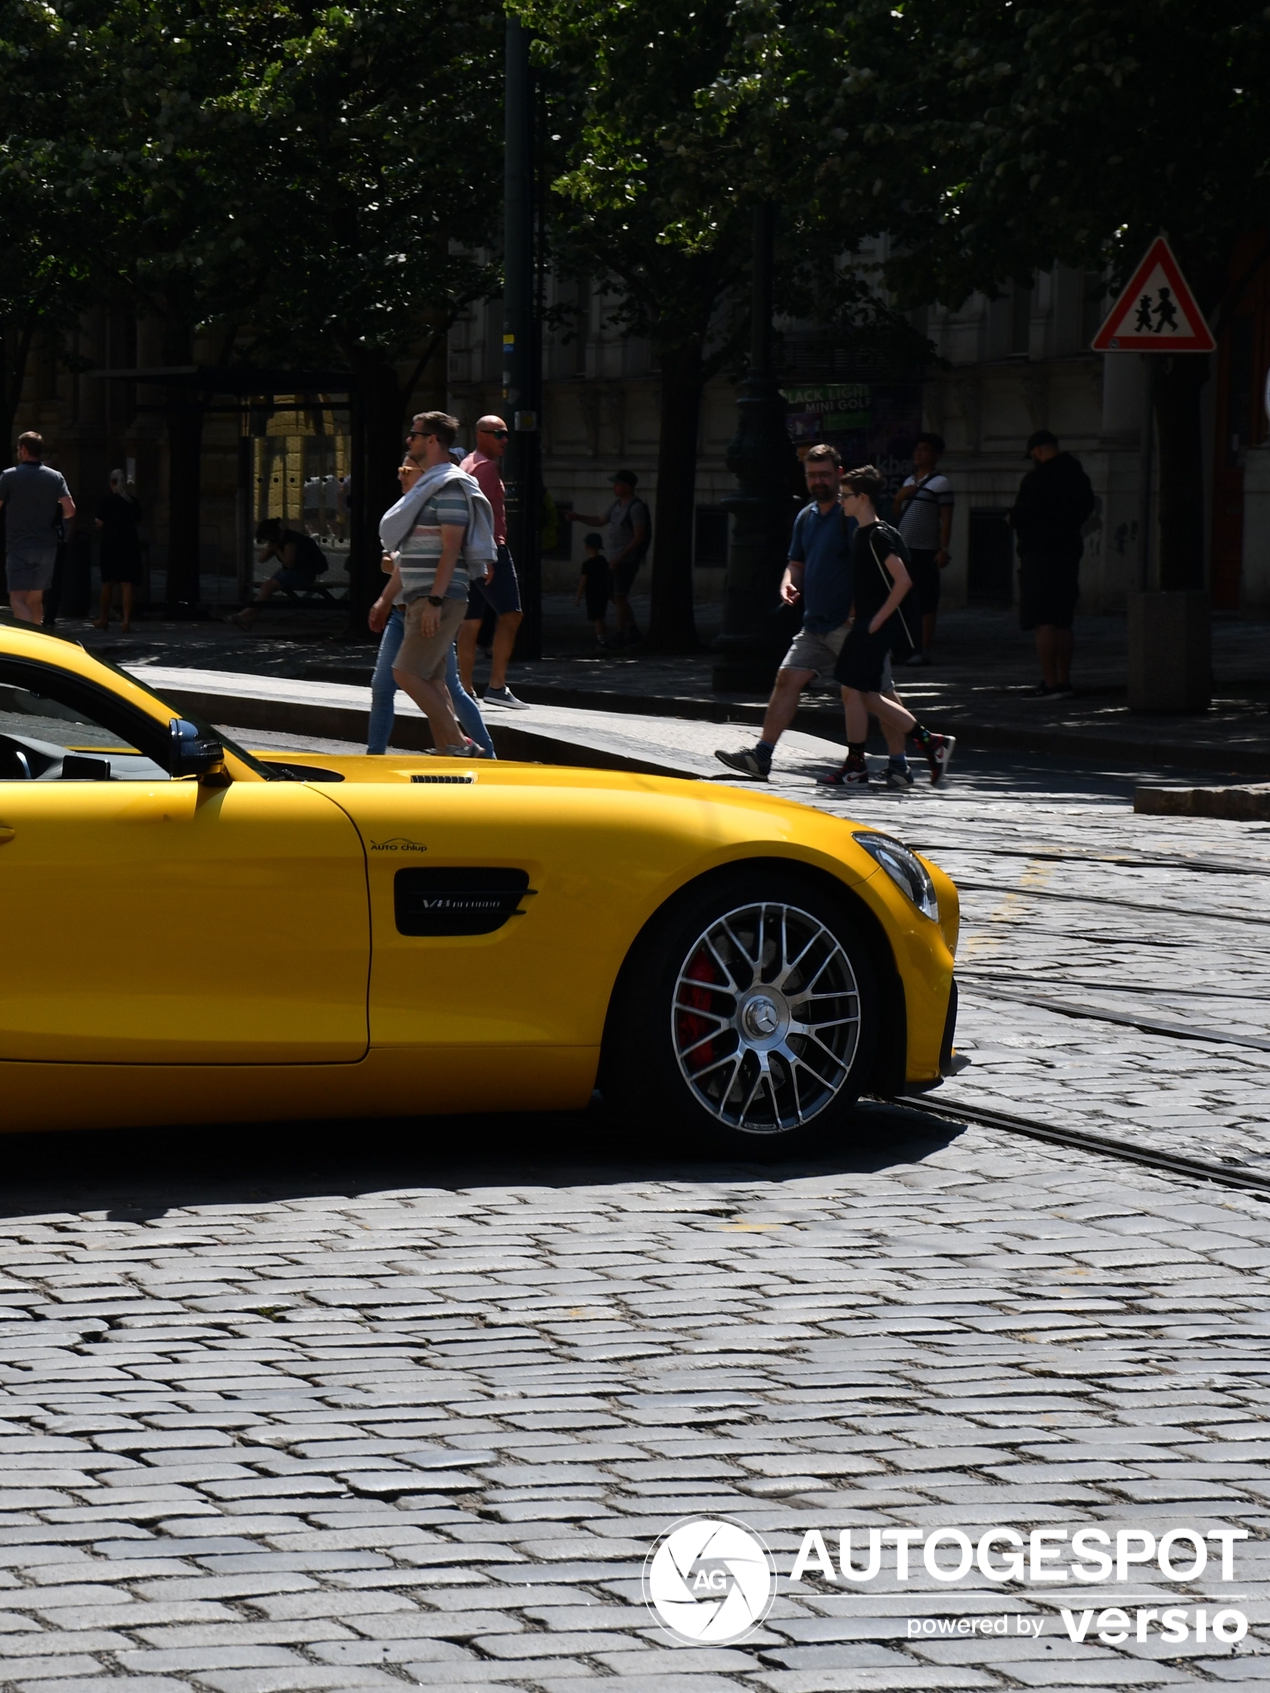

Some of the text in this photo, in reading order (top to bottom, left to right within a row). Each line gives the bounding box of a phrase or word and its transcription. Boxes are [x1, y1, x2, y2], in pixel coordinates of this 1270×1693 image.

[805, 401, 835, 413] MINI
[838, 397, 873, 411] GOLF
[422, 899, 451, 909] V8
